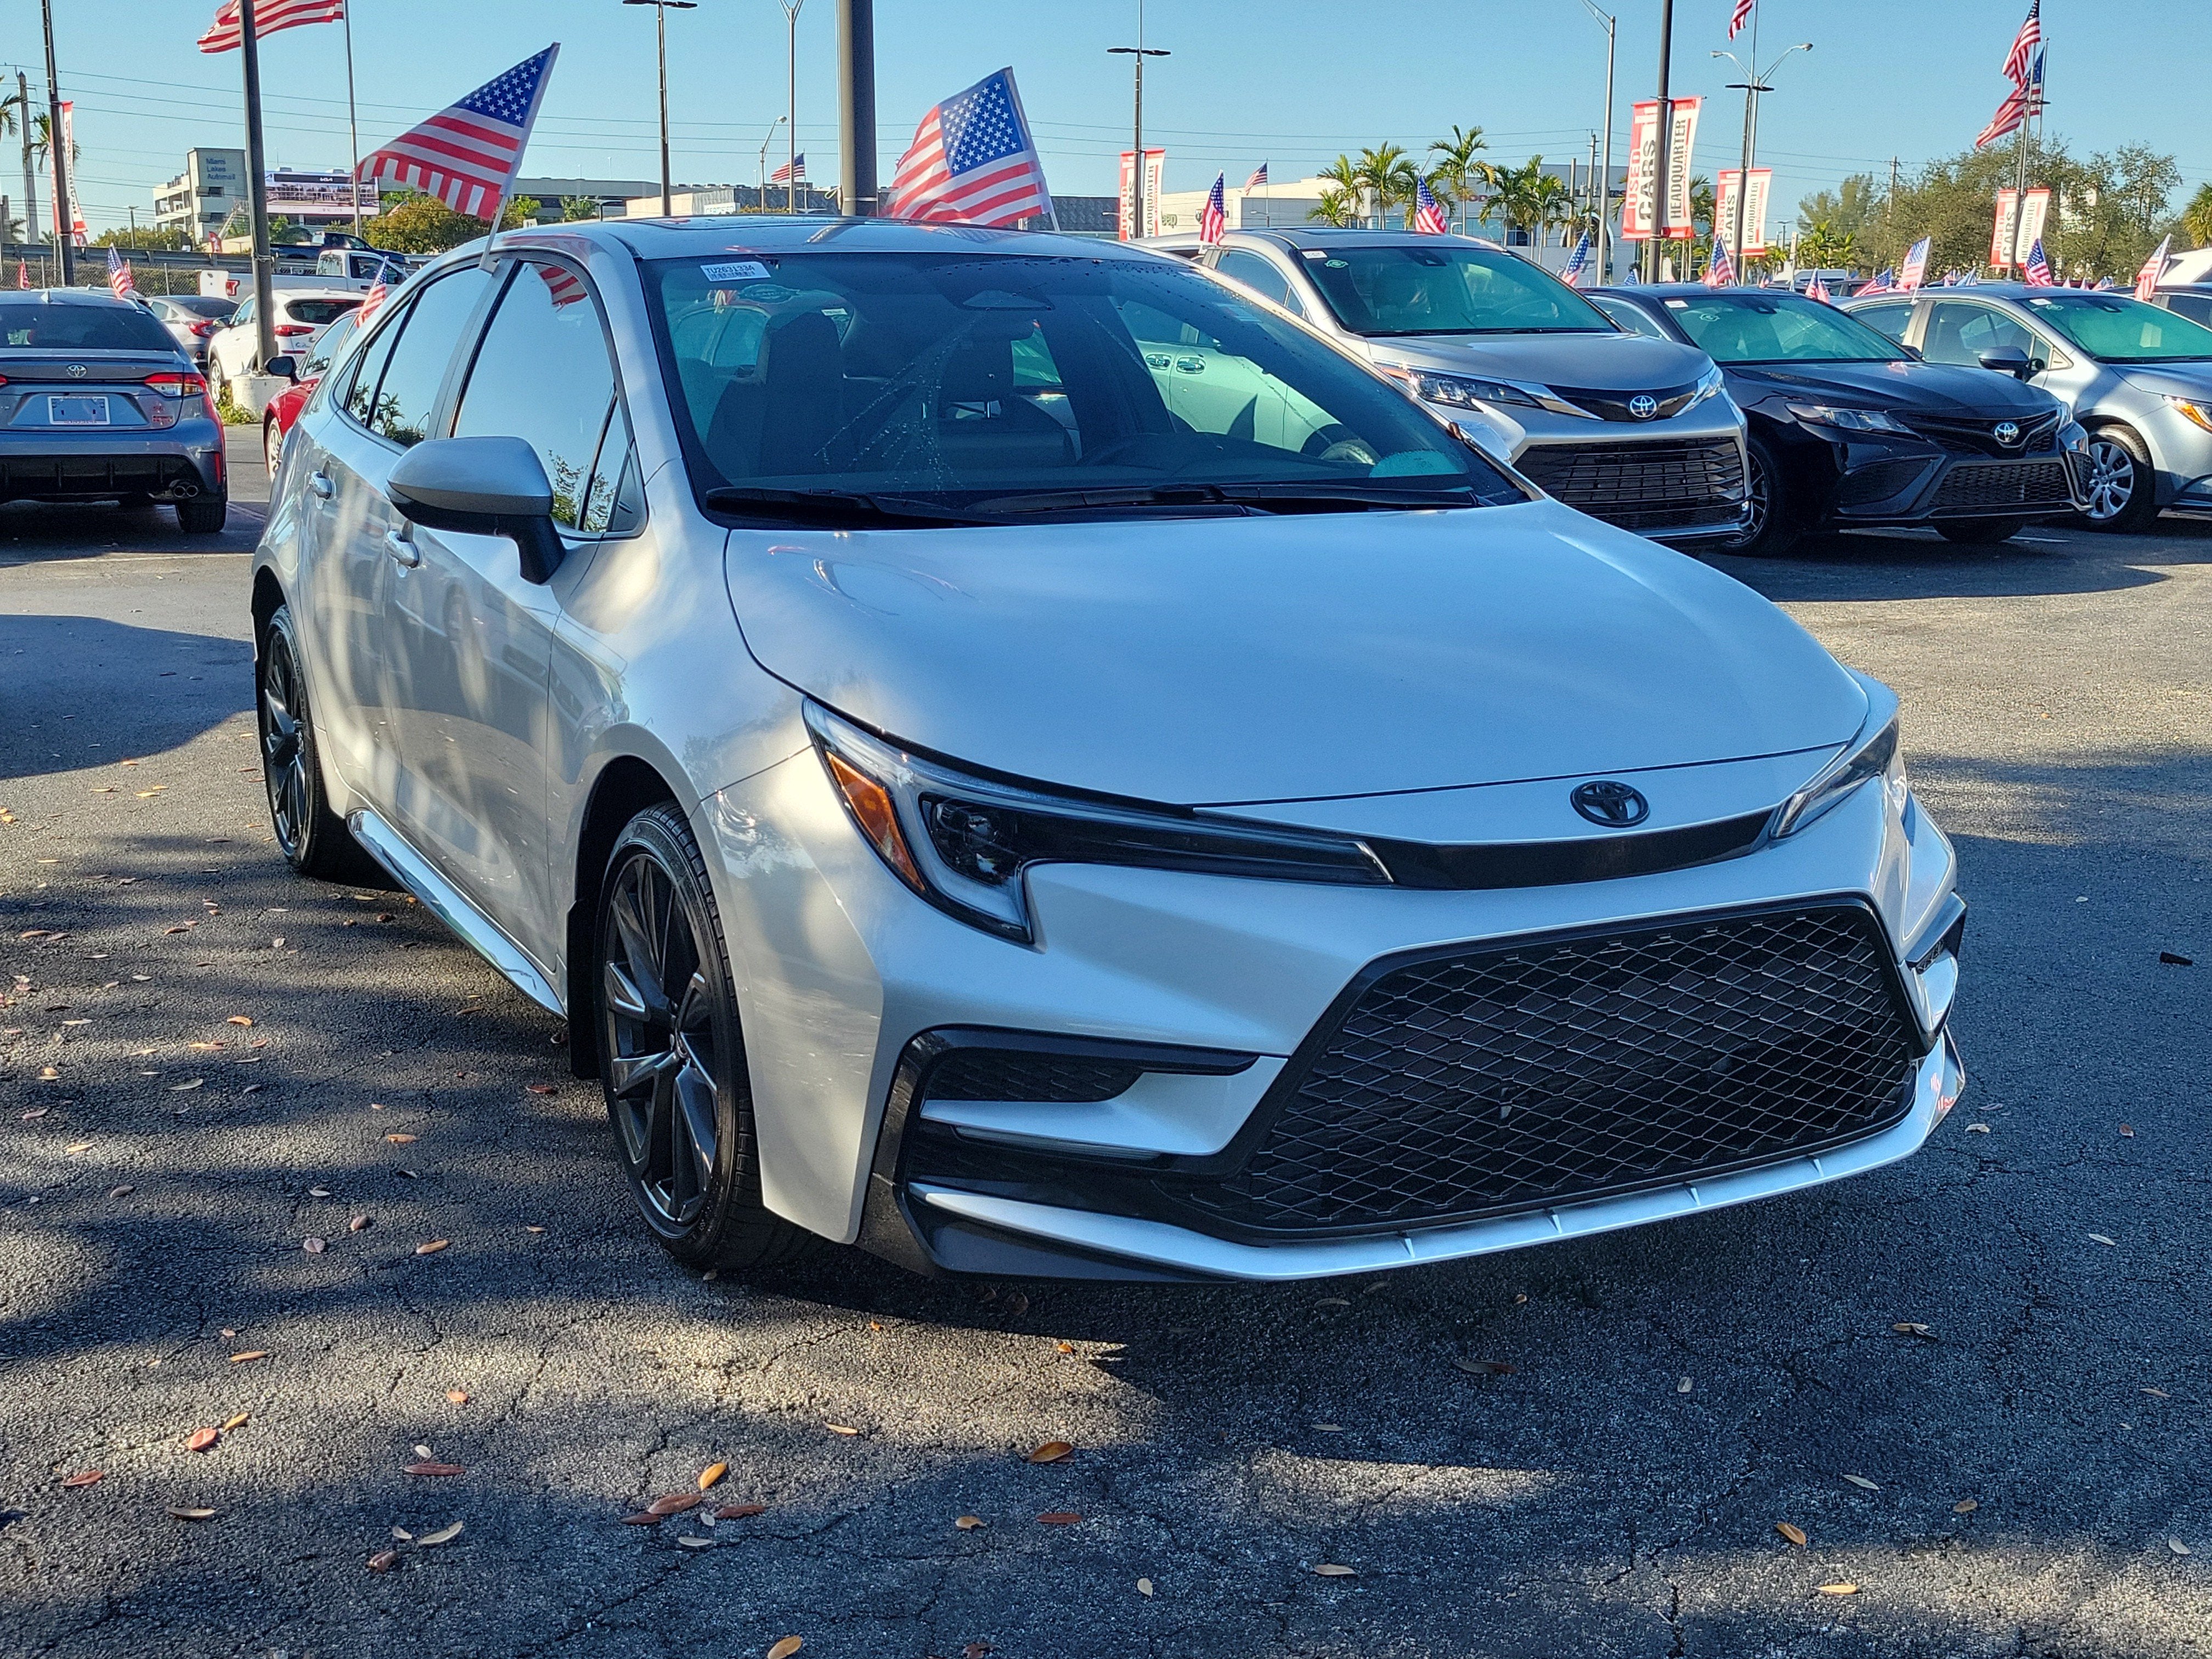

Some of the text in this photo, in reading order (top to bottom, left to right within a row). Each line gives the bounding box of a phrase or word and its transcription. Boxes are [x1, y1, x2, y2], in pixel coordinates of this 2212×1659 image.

[1627, 150, 1641, 207] USED
[1639, 139, 1656, 221] CARS
[1671, 119, 1686, 219] HEADQUARTER
[1724, 194, 1735, 244] CARS
[1747, 182, 1758, 244] HEADQUARTER
[1995, 217, 2005, 249] USED
[2002, 211, 2015, 257] CARS
[2021, 202, 2036, 259] HEADQUARTER
